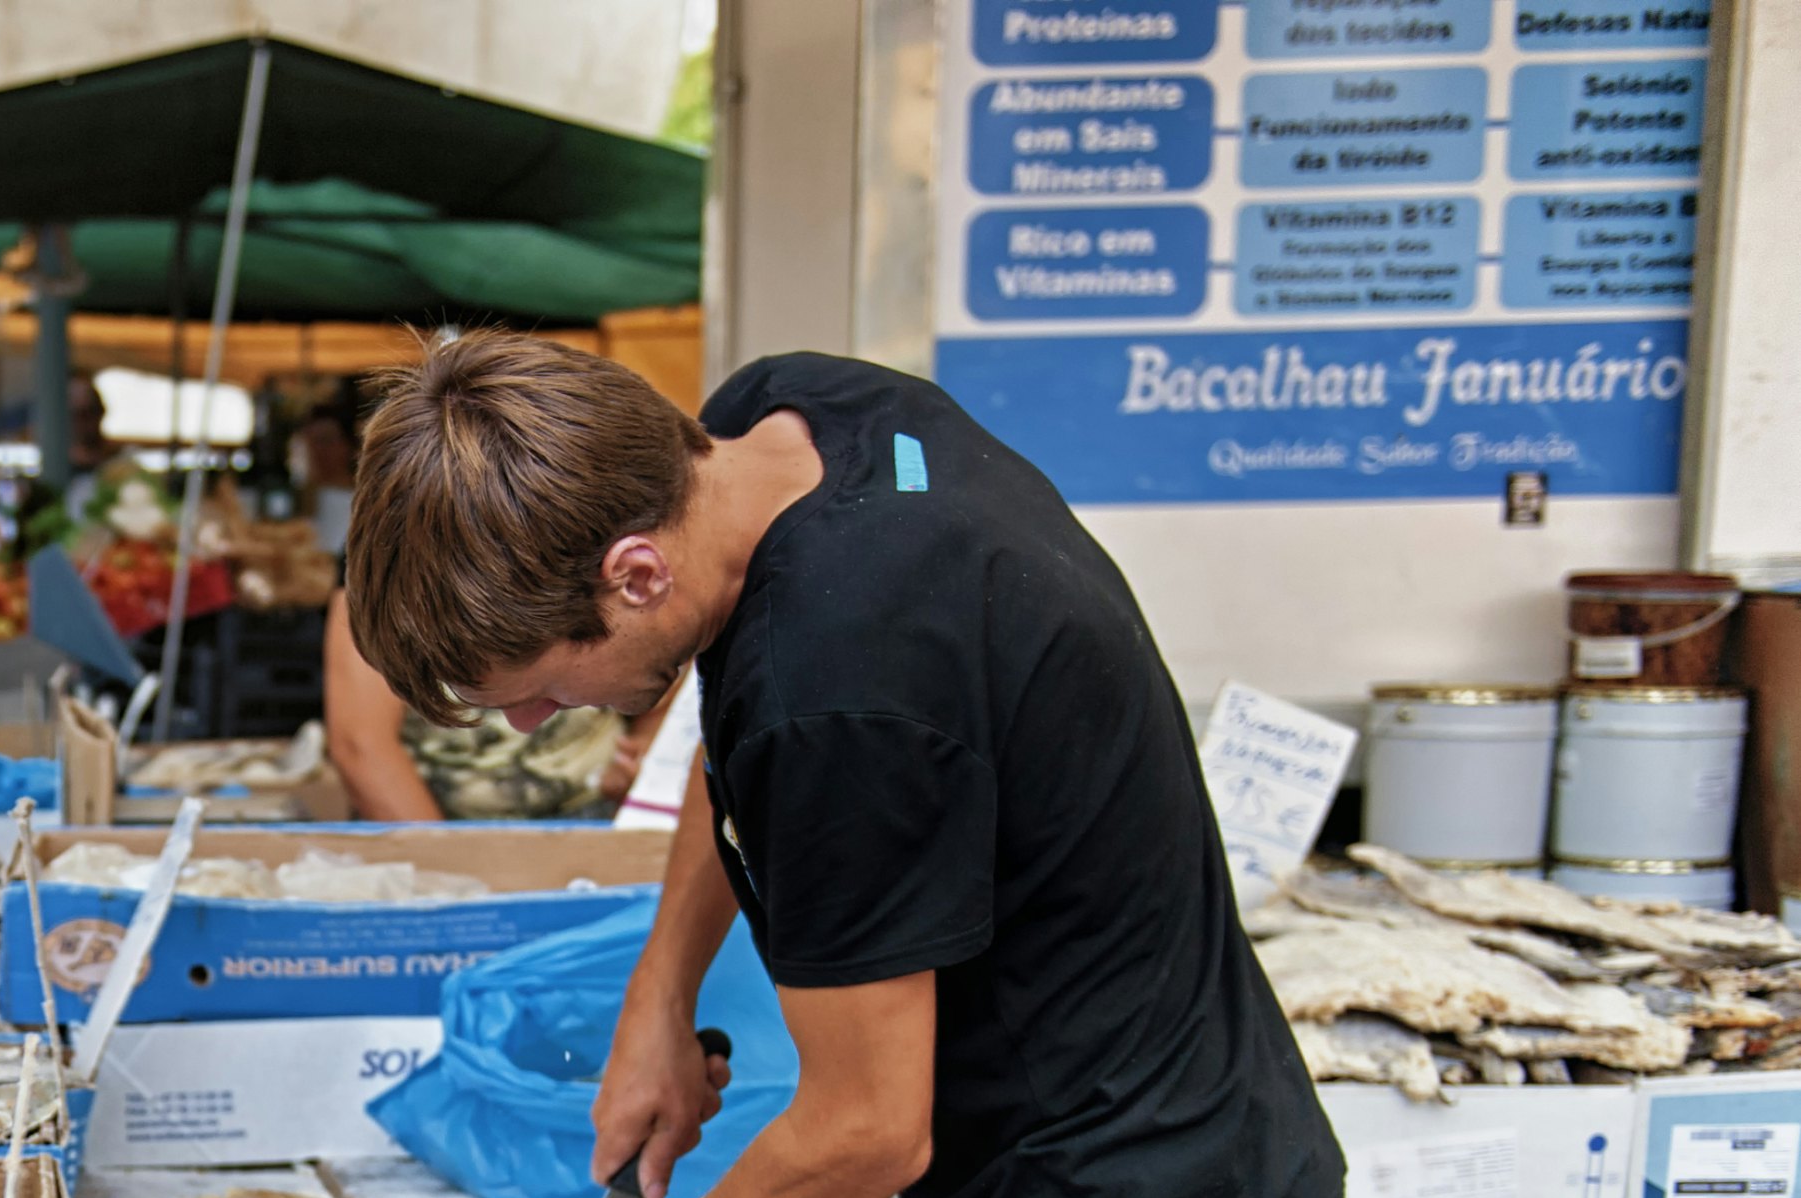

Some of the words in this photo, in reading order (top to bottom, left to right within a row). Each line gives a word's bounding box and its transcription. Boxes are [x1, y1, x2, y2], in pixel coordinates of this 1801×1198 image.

[1517, 10, 1631, 36] Defesas
[990, 79, 1185, 114] Abundante
[1012, 127, 1072, 154] em
[1078, 117, 1156, 151] Sais
[1008, 225, 1092, 258] Rico
[1096, 228, 1157, 256] em
[994, 264, 1178, 300] Vitaminas
[1117, 344, 1388, 414] Bacalhau
[1402, 337, 1686, 427] Januário
[222, 954, 399, 979] SUPERIOR
[404, 950, 494, 977] HAU
